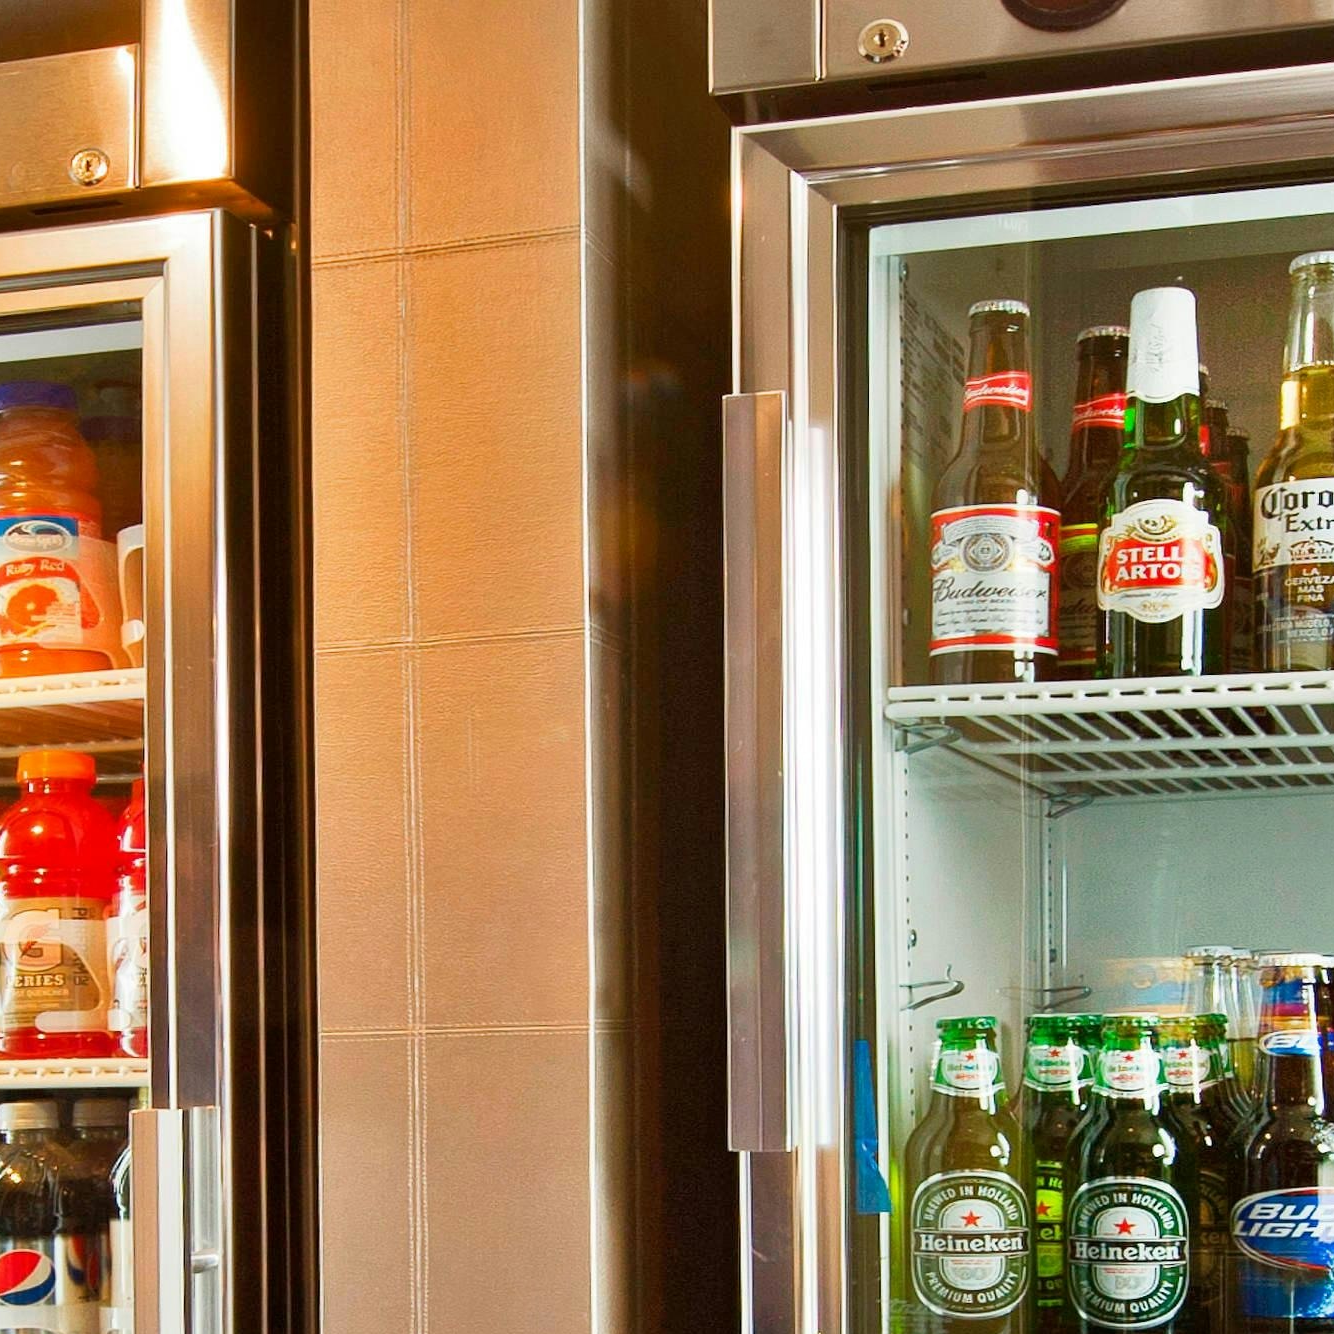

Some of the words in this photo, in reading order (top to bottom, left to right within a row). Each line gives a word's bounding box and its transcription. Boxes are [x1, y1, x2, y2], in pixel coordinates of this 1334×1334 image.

[5, 562, 36, 577] Ruby
[40, 559, 66, 572] Red
[1302, 567, 1320, 577] LA
[1297, 593, 1325, 603] FINA
[959, 1185, 974, 1197] IN
[977, 1186, 1019, 1223] HOLLAND
[1113, 1192, 1128, 1205] IN
[1131, 1193, 1176, 1231] HOLLAND
[919, 1232, 1025, 1253] Heineken
[1074, 1240, 1182, 1261] Heineken
[924, 1270, 974, 1304] PREMIUM
[977, 1270, 1020, 1304] QUALITY
[1130, 1278, 1176, 1314] QUALITY
